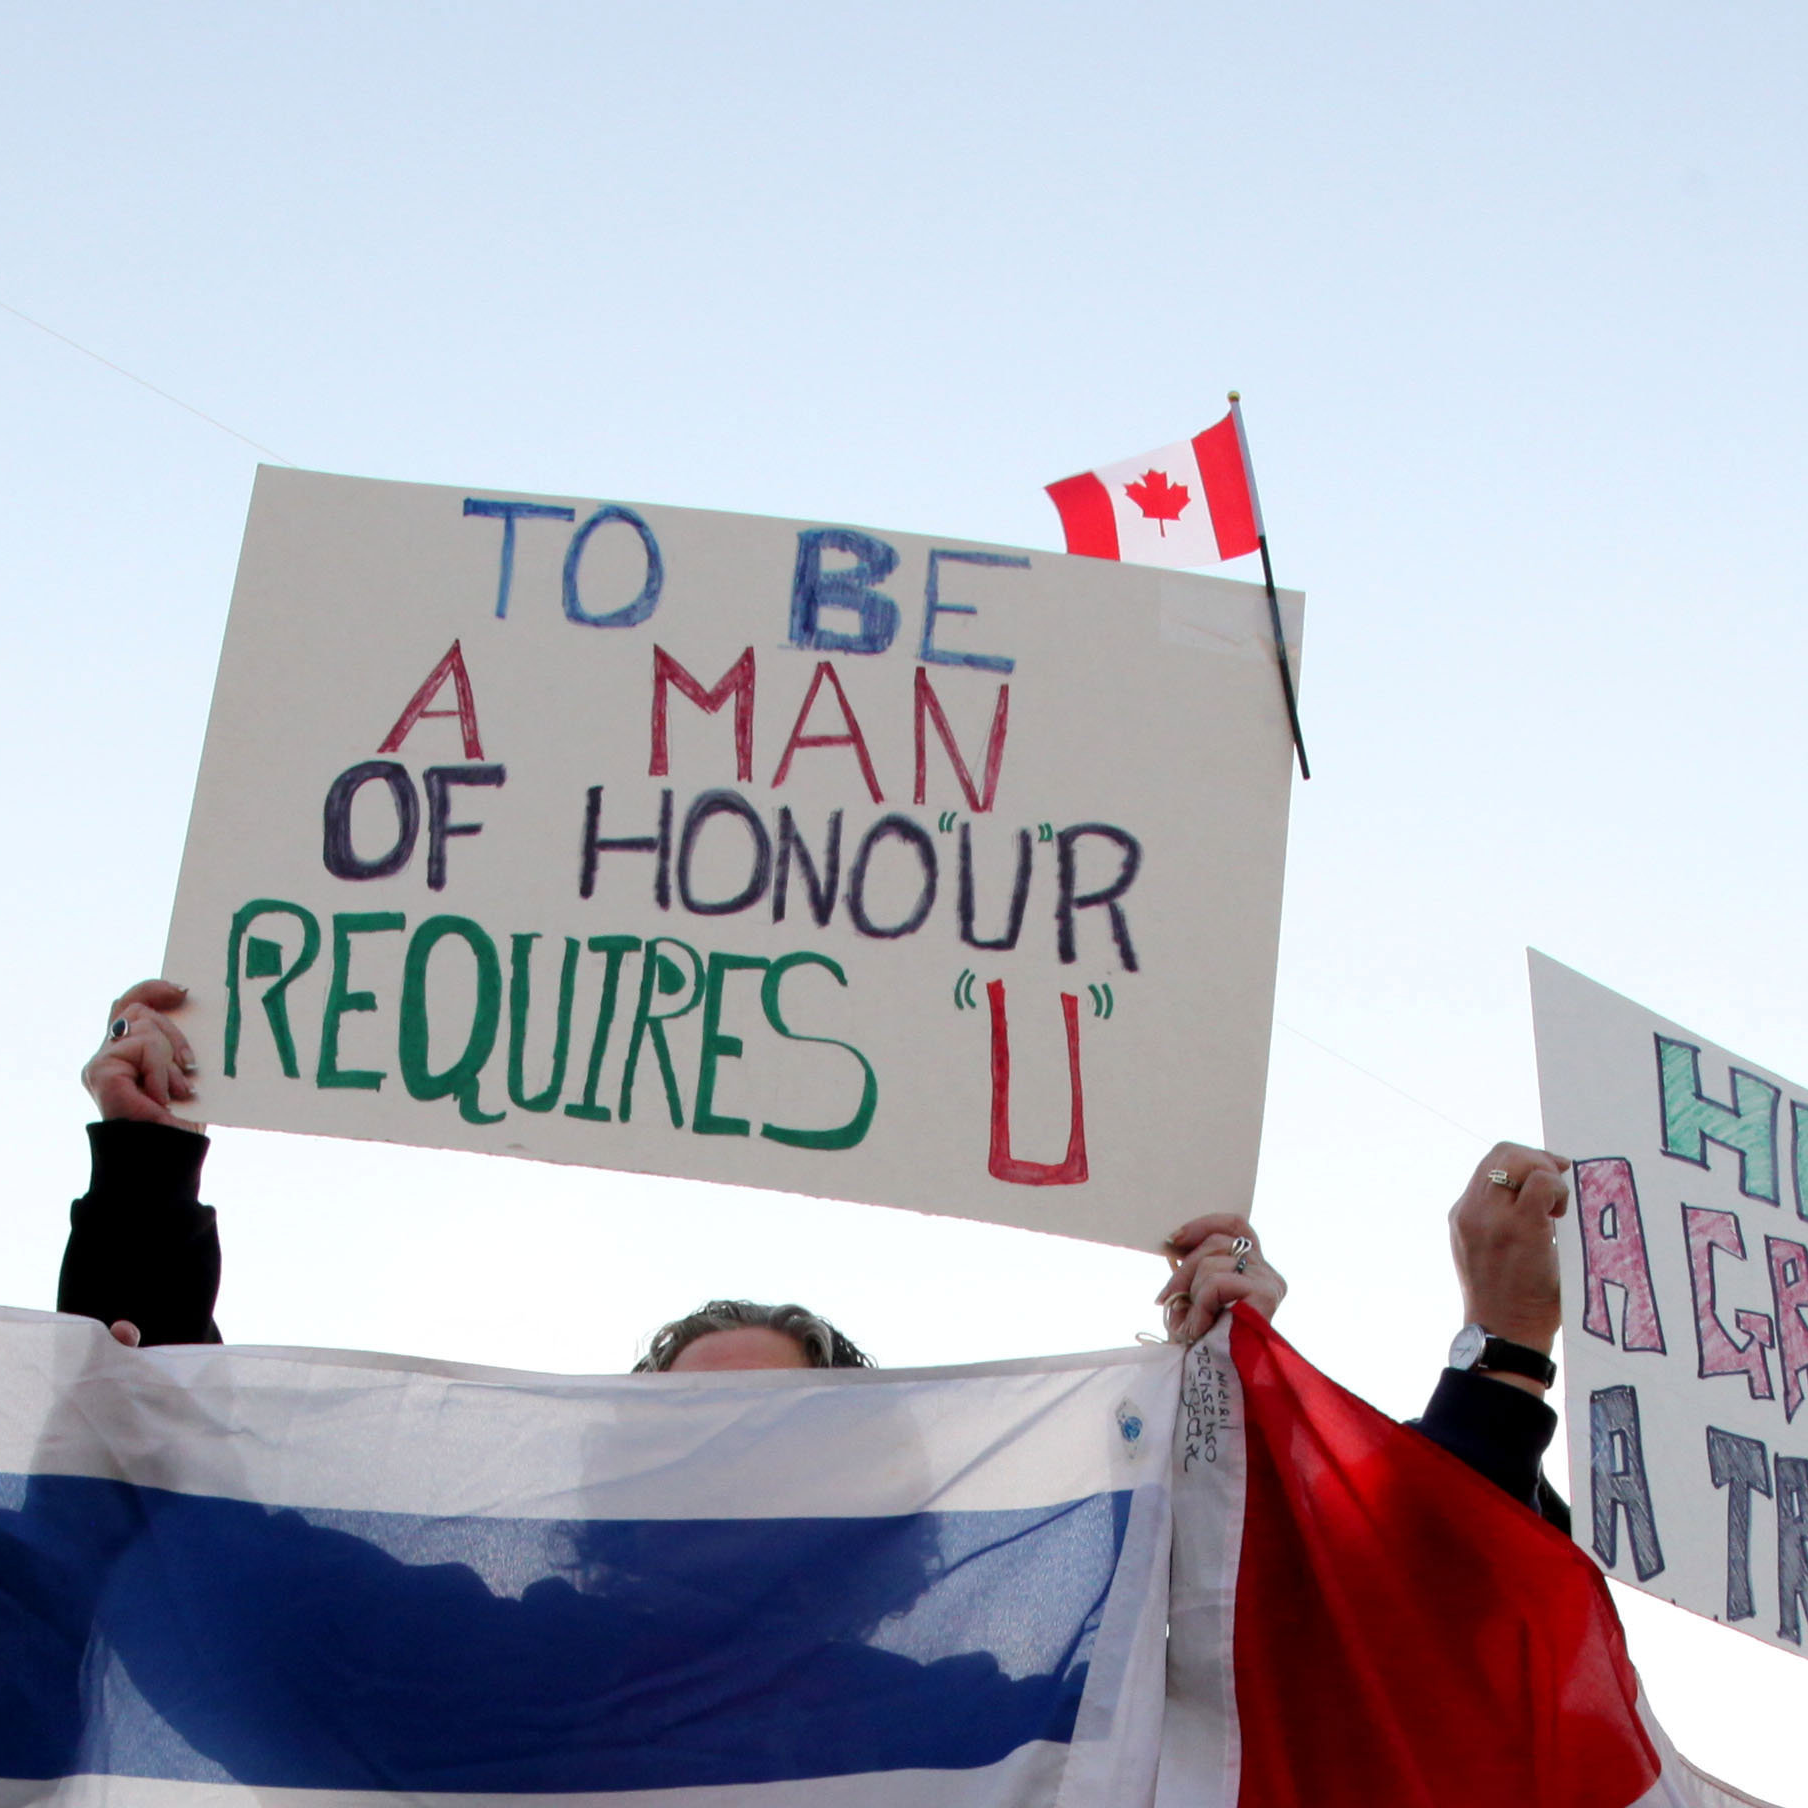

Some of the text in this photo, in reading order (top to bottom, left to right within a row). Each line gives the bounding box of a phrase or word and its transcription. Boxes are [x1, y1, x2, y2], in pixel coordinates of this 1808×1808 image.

[462, 498, 1032, 675] TO BE
[376, 638, 1009, 813] A MAN
[323, 759, 506, 893] OF
[223, 898, 879, 1151] REQUIRES
[1573, 1156, 1666, 1356] A
[1590, 1385, 1665, 1582] A
